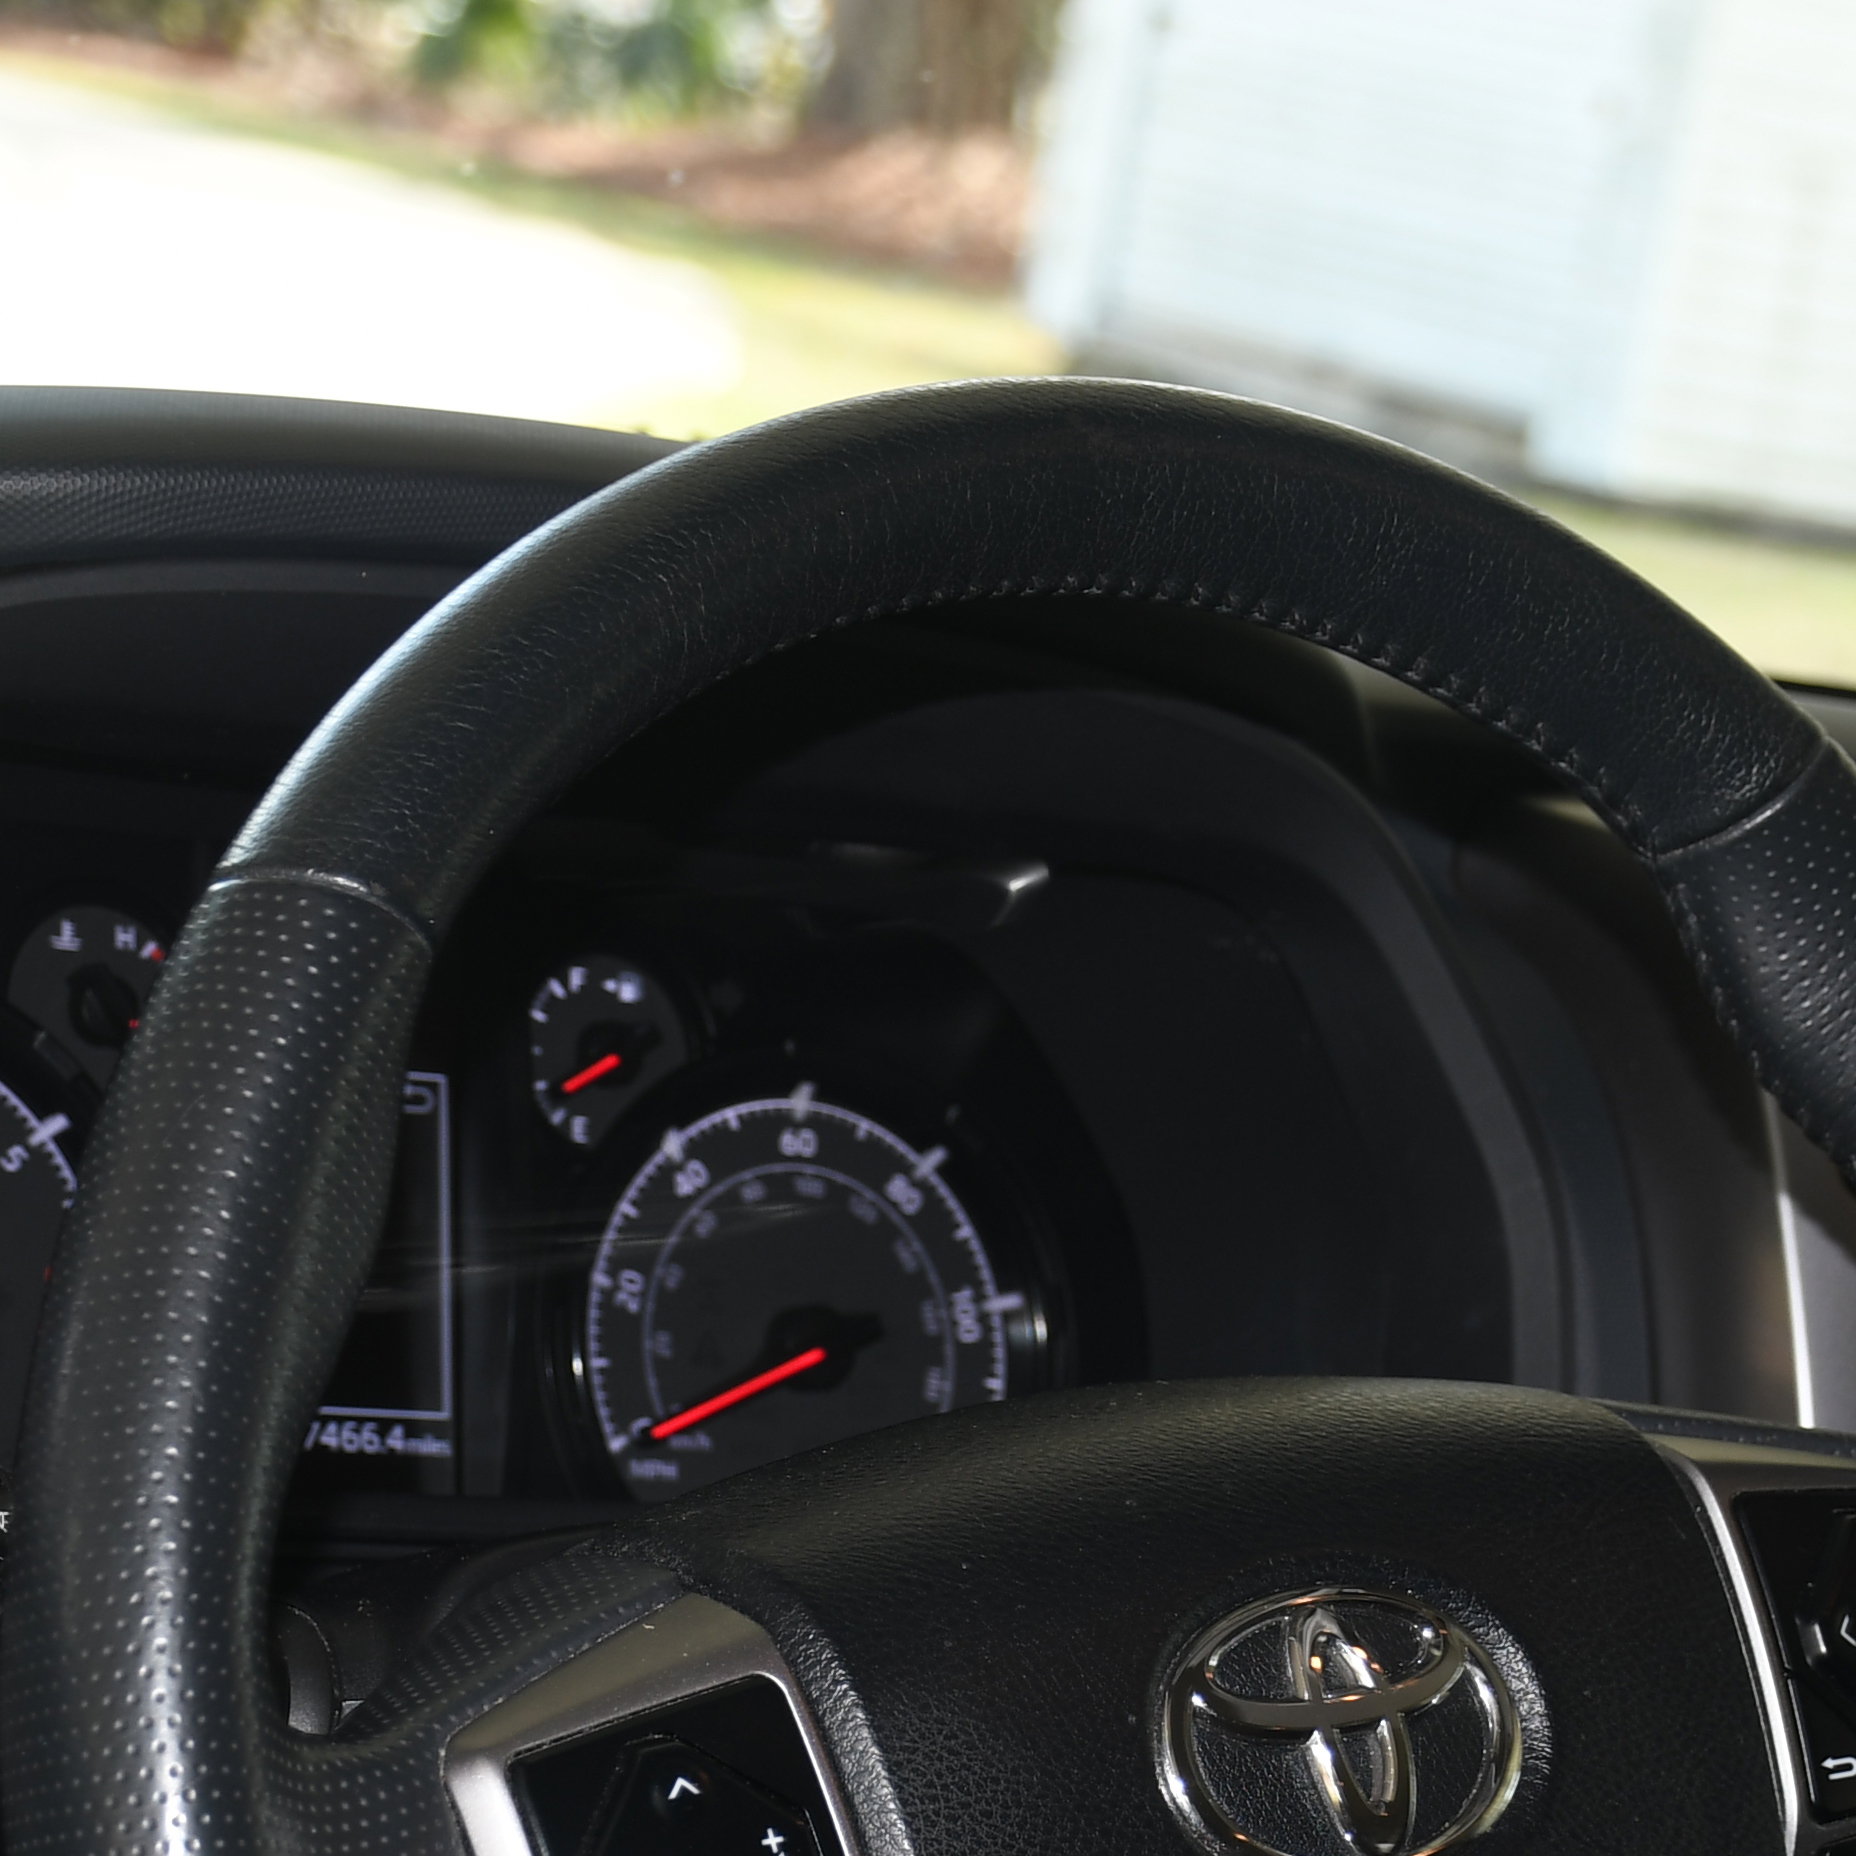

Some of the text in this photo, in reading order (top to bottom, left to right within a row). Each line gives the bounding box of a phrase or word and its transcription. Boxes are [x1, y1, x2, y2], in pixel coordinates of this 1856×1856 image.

[115, 926, 137, 948] H
[568, 966, 588, 993] F
[571, 1115, 590, 1144] E
[778, 1128, 820, 1158] 60
[673, 1159, 710, 1197] 40
[884, 1173, 925, 1216] 80
[613, 1268, 646, 1314] 20
[950, 1286, 983, 1343] 100
